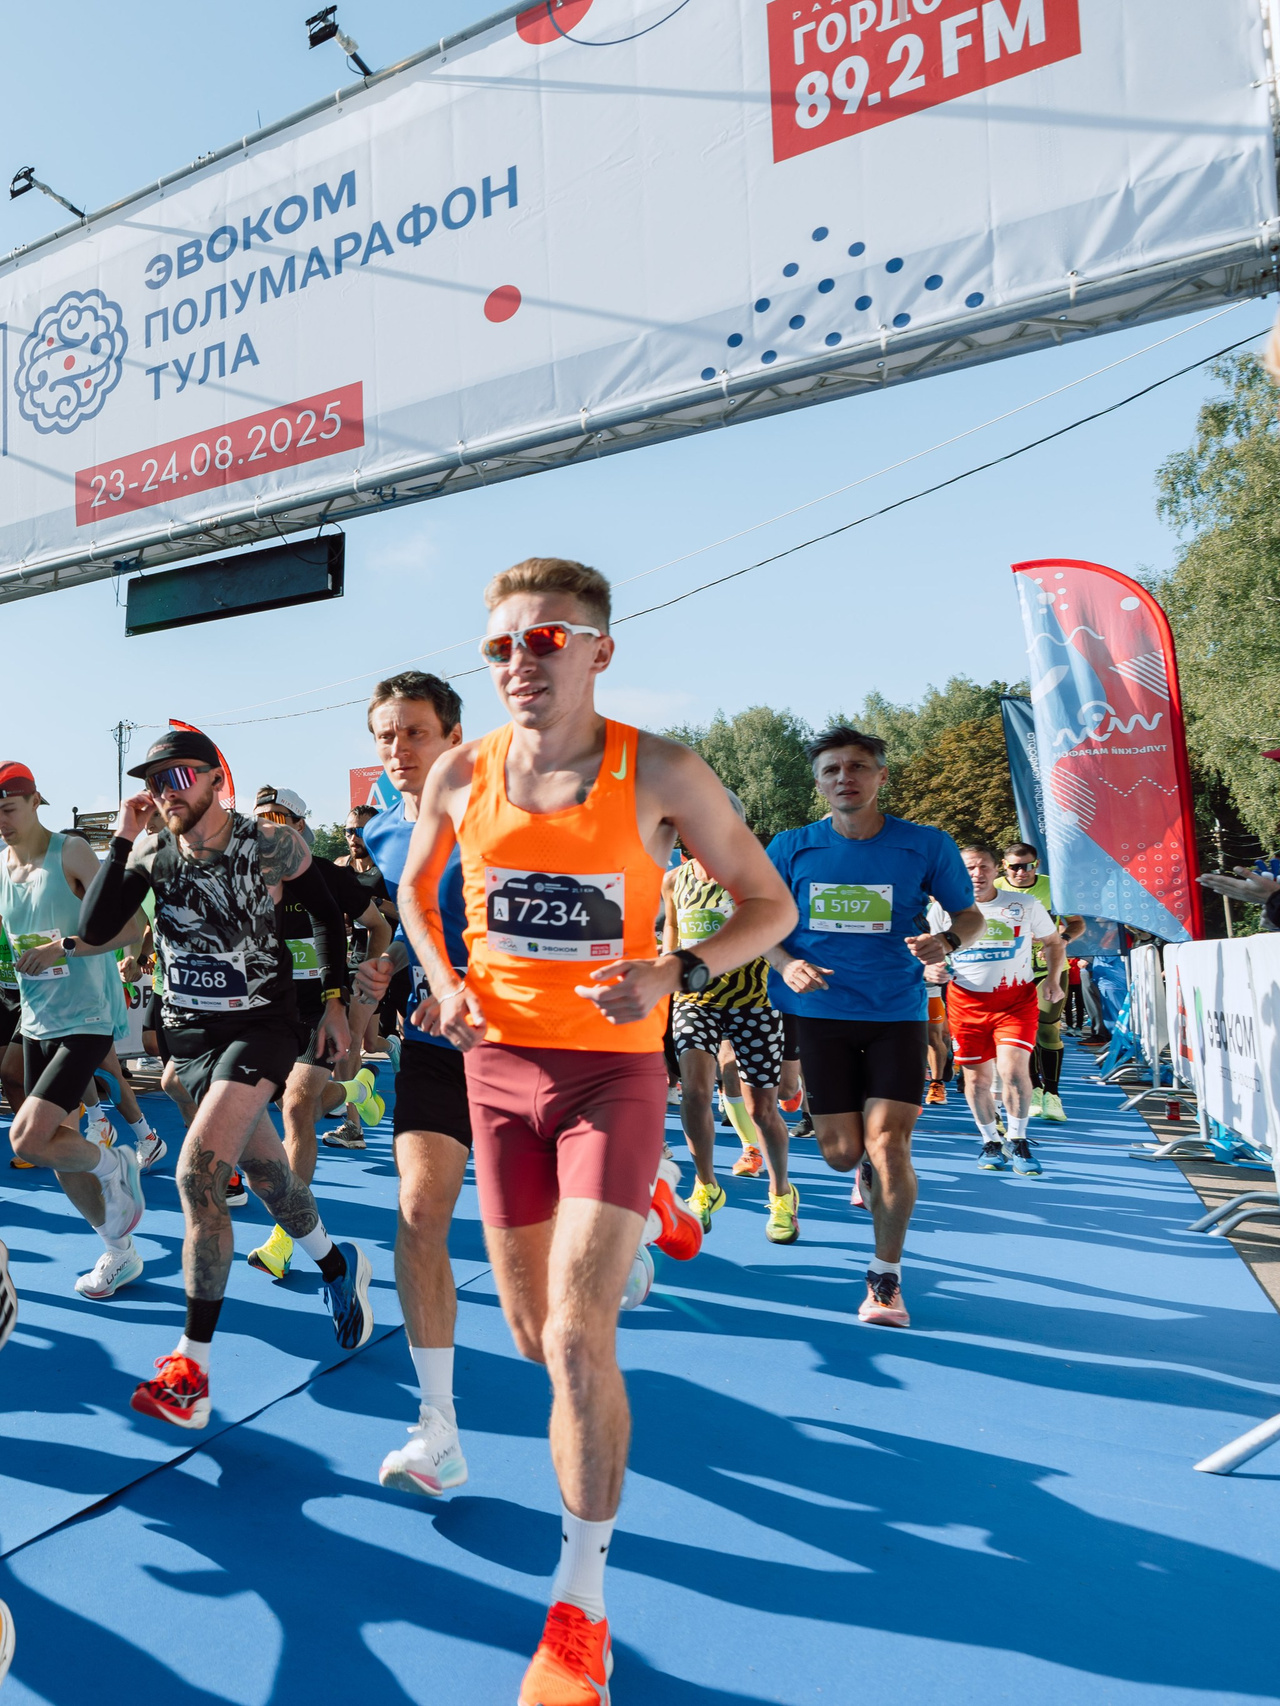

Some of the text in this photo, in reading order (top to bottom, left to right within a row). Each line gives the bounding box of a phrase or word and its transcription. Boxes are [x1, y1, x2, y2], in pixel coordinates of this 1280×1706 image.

[794, 0, 1046, 129] 89.2 FM
[144, 169, 357, 290] ЭВОКОМ
[145, 165, 518, 348] ПОЛУМАРАФОН
[145, 333, 260, 400] ТУЛА
[90, 401, 343, 508] 23-24.08.2025
[514, 897, 590, 927] 7234
[688, 920, 721, 933] 5266
[830, 899, 871, 913] 5197
[542, 945, 578, 953] ЭВОКОМ
[180, 968, 227, 988] 7268
[1207, 1009, 1257, 1060] ЭВОКОМ
